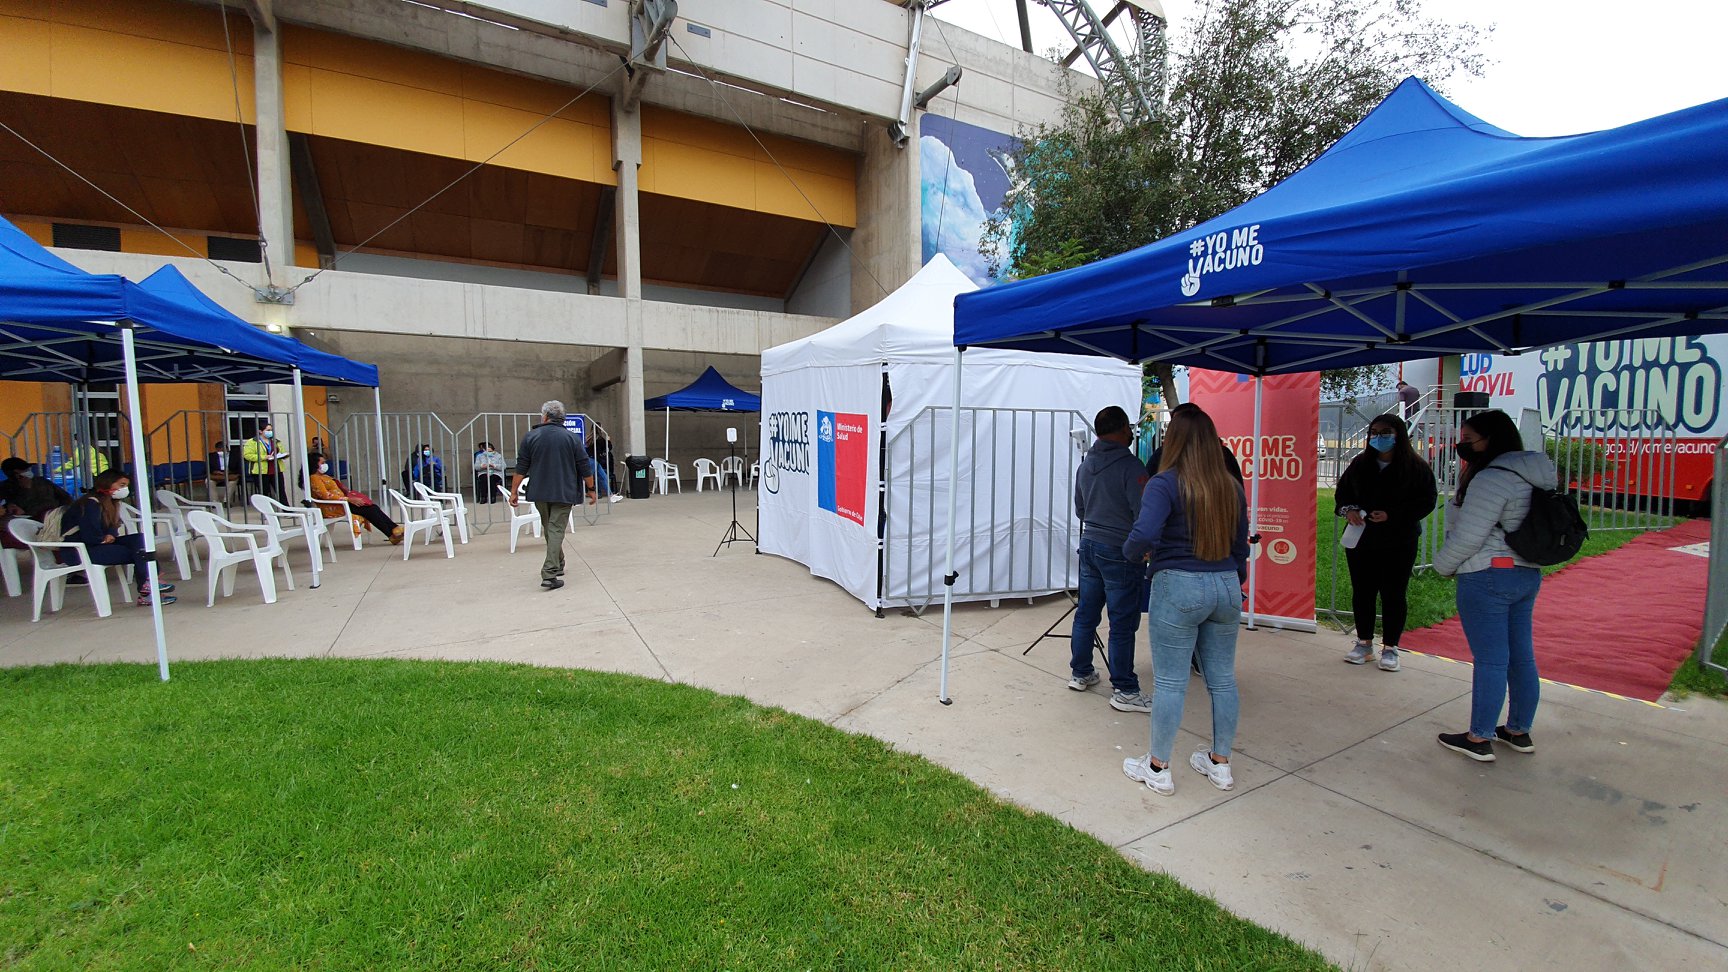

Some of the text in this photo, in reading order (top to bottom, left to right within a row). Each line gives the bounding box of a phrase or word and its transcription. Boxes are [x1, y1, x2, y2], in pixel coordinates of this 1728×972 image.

[1189, 224, 1260, 257] #YO ME
[1186, 244, 1264, 281] VACUNO
[1460, 354, 1493, 376] LUD
[1537, 359, 1720, 434] VACUNO
[837, 422, 856, 433] Ministerio
[837, 431, 849, 441] Salud
[1219, 435, 1296, 458] YO ME
[1241, 457, 1302, 480] CUNO
